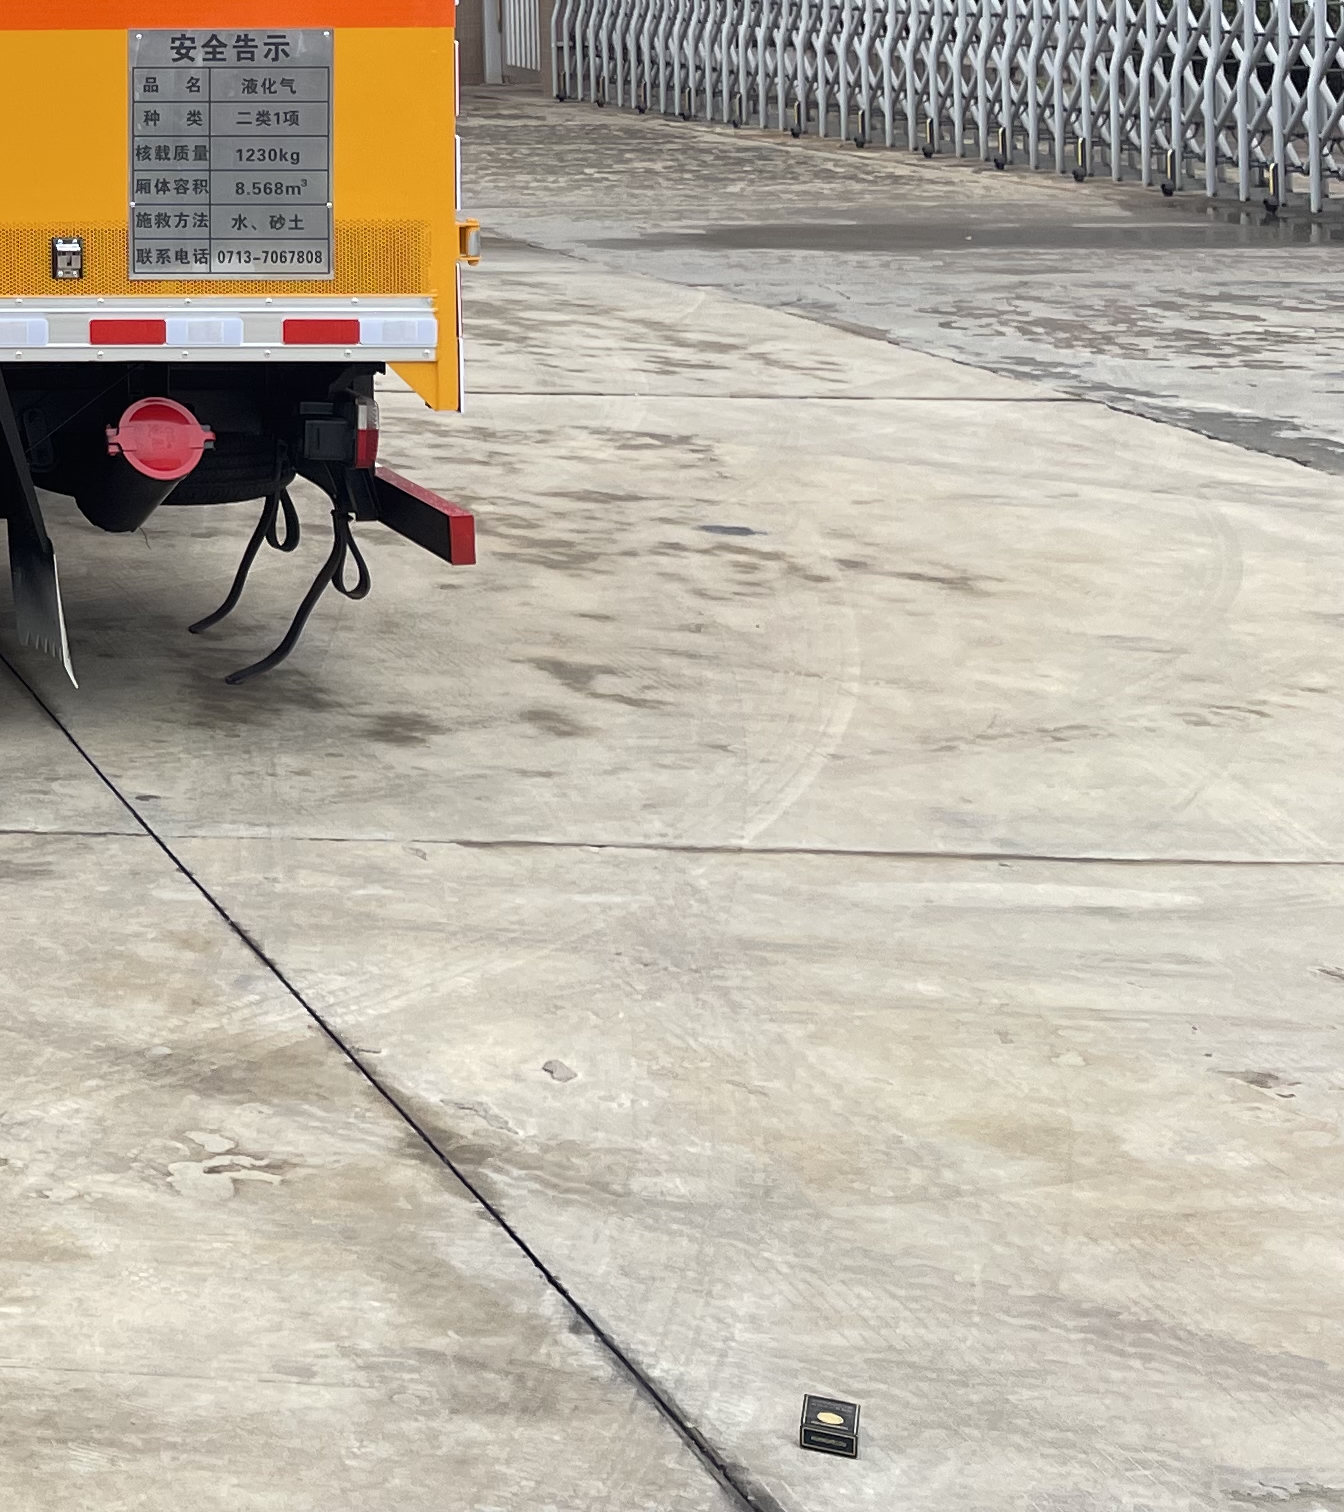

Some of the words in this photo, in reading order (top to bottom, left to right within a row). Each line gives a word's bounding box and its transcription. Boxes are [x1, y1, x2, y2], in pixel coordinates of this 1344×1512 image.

[170, 34, 290, 63] 安全告示
[241, 77, 297, 95] 液化气
[236, 110, 299, 127] 二类1项
[135, 144, 209, 163] 核载质量
[236, 147, 300, 165] 1230kg
[135, 178, 209, 196] 厢体容积
[135, 212, 209, 230] 施救方法
[231, 214, 305, 231] 水、砂土
[135, 248, 209, 266] 联系电话
[217, 249, 323, 265] 0713-7067808
